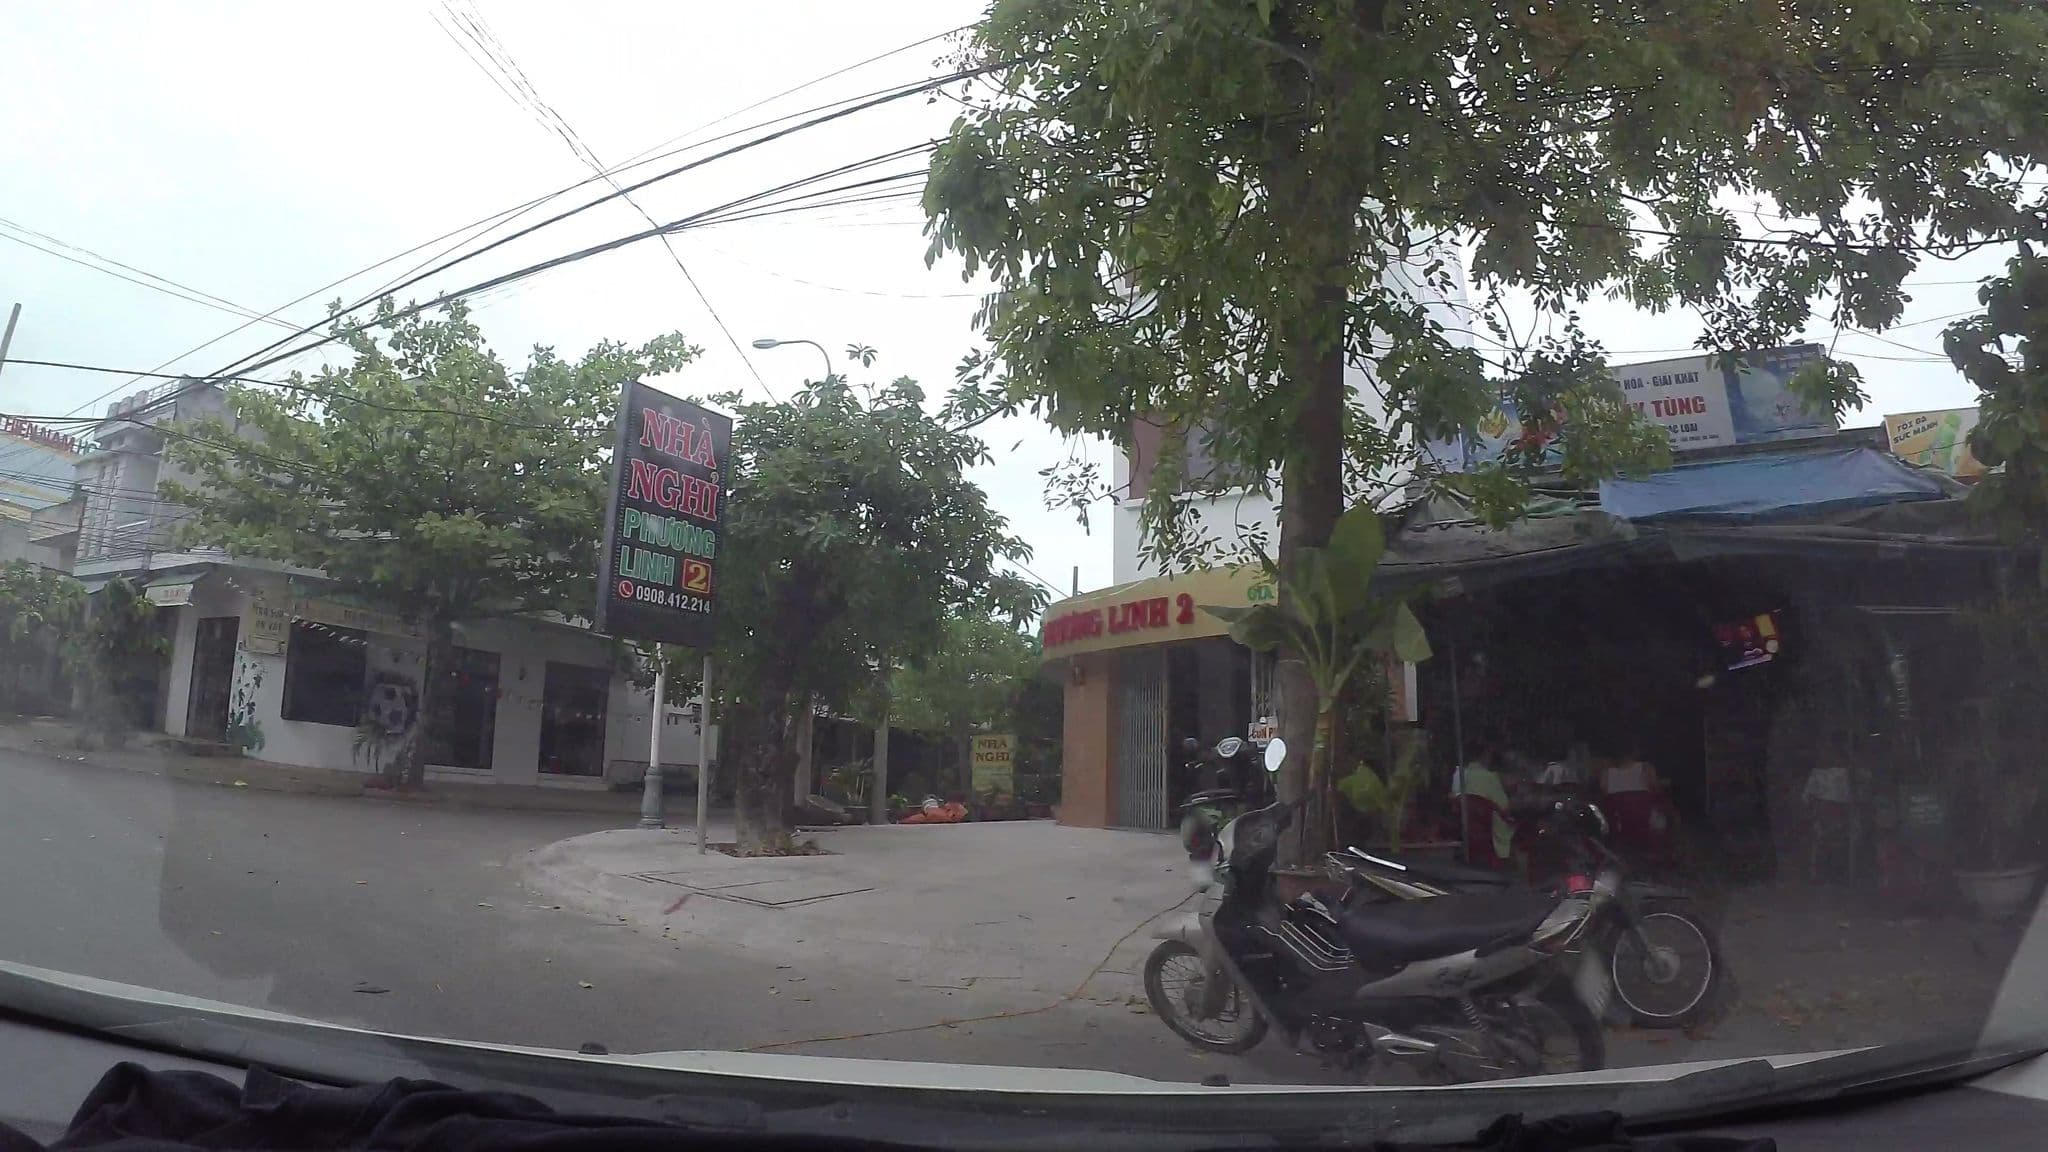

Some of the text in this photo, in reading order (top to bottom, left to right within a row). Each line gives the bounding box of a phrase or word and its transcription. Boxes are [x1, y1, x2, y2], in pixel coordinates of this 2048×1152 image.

[640, 408, 717, 470] NHÀ
[628, 458, 720, 521] NGHỈ
[623, 507, 716, 559] PHƯƠNG
[619, 545, 709, 591] LINH 2
[636, 585, 711, 614] 0908.412.214
[1108, 596, 1169, 633] LINH
[1176, 593, 1195, 624] 2
